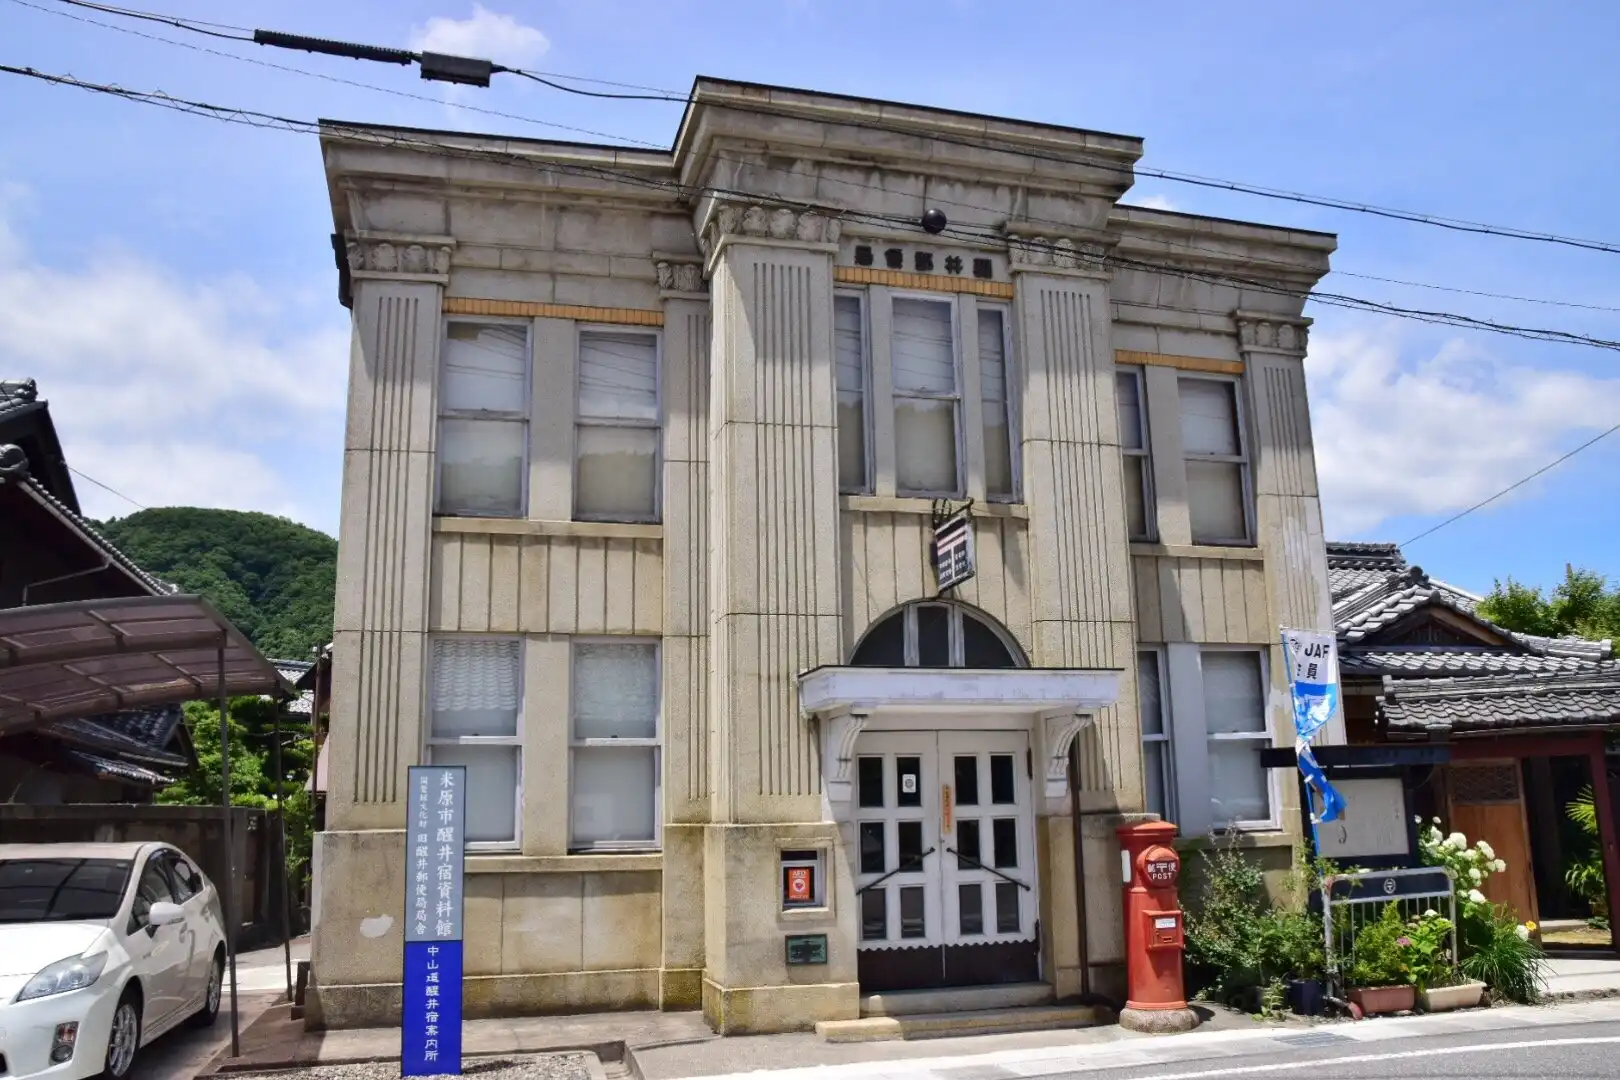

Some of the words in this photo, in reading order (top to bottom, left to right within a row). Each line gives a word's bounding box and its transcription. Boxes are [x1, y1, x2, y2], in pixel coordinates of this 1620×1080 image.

[1304, 642, 1330, 658] JAF
[435, 771, 456, 937] 米原市醒井宿資料館
[1152, 872, 1173, 880] POST
[423, 946, 440, 1062] 中山道醒井宿案内所
